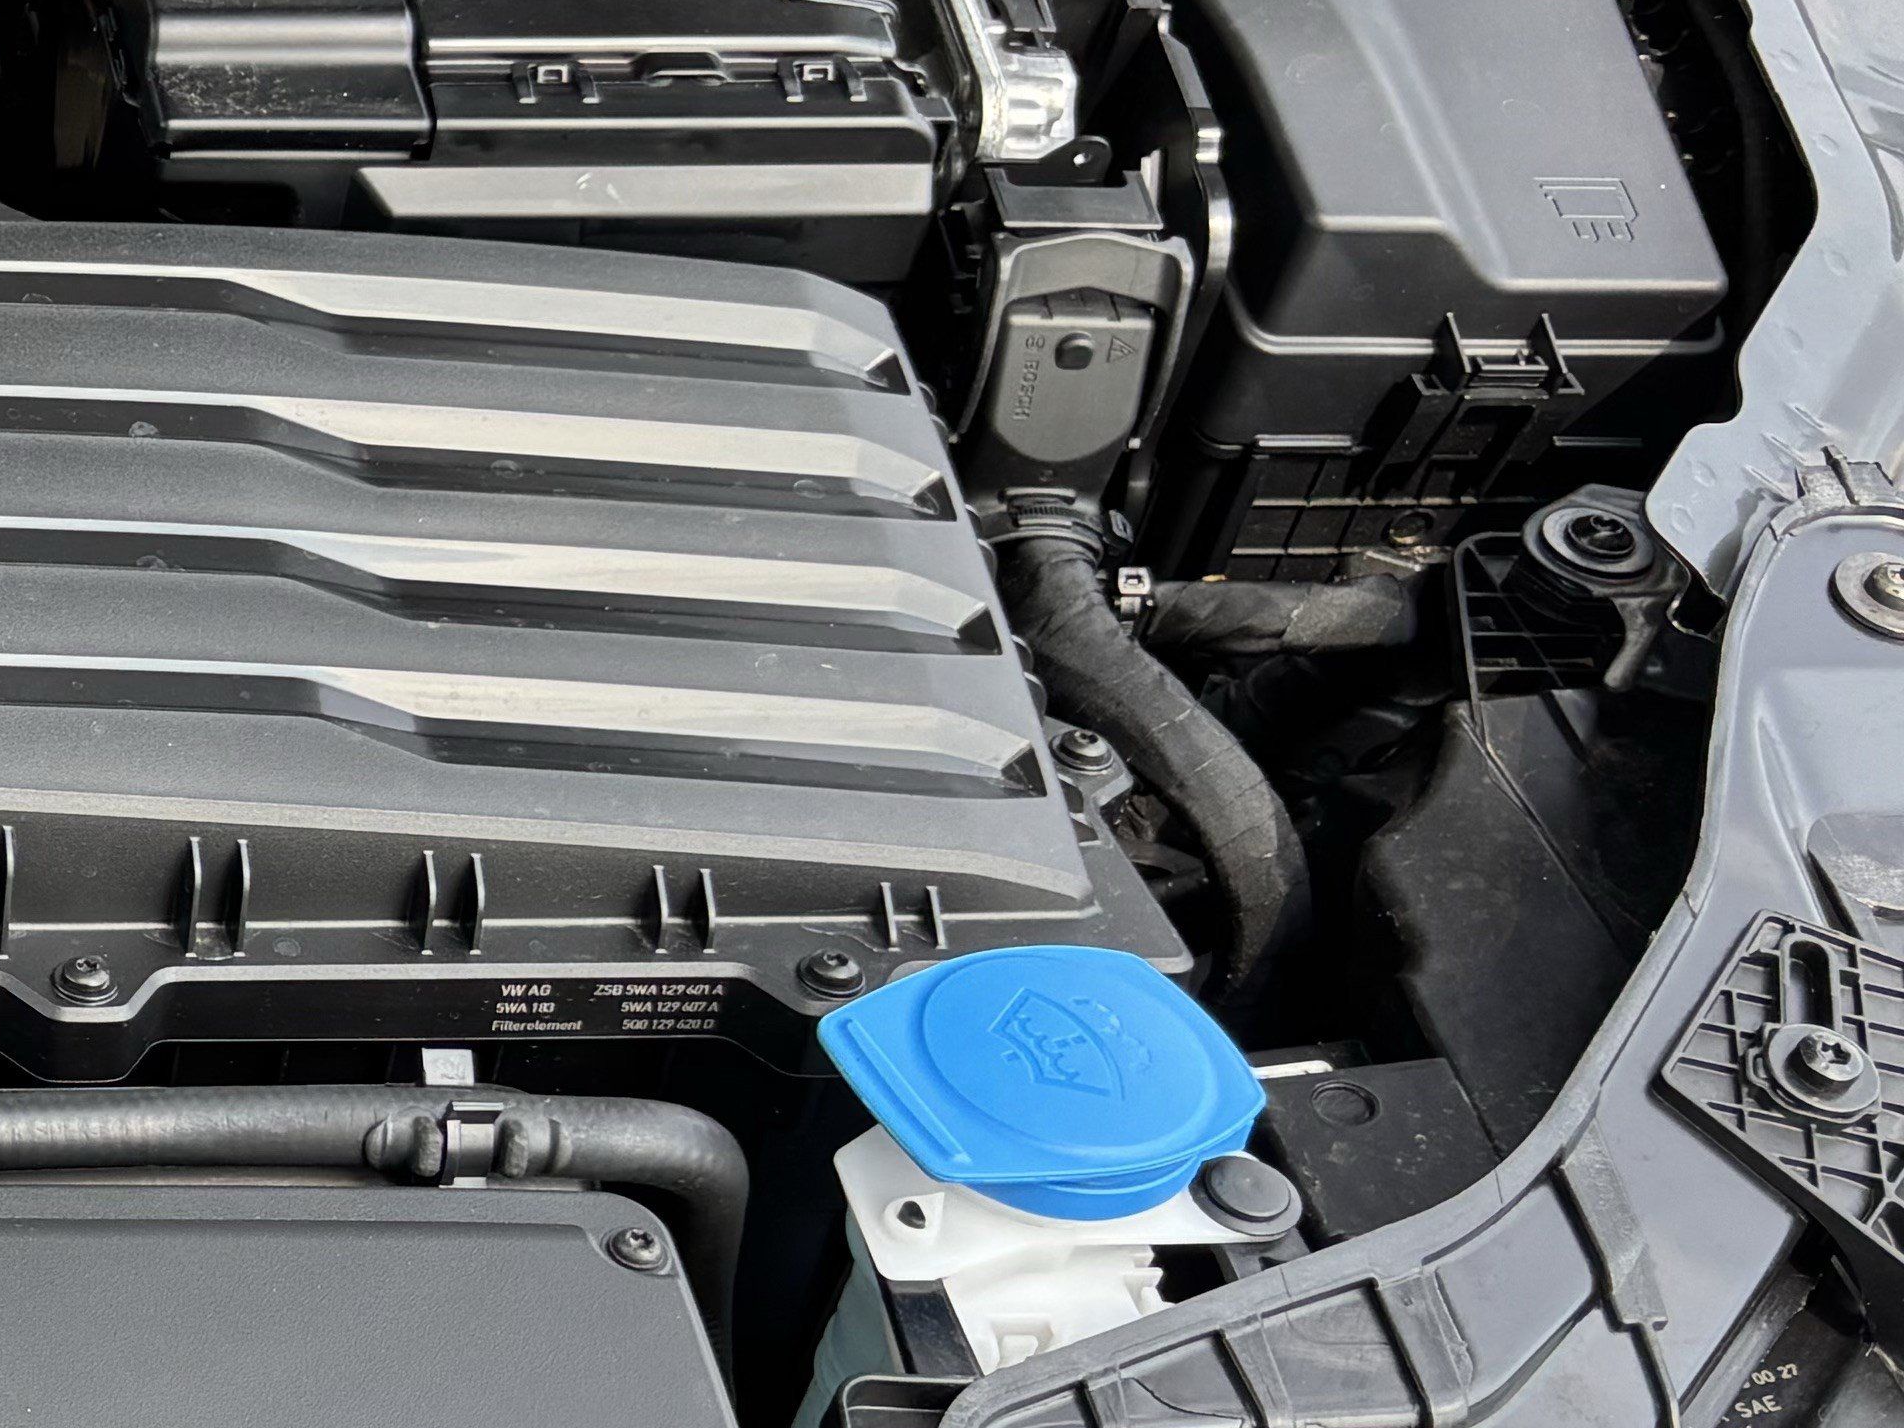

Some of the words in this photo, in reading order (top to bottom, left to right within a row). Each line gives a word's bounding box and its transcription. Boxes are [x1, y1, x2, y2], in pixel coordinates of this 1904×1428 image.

[500, 984, 526, 996] VW
[527, 984, 551, 996] AG
[593, 984, 623, 996] ZSB
[623, 984, 657, 995] 5WA
[661, 984, 685, 995] 129
[711, 984, 723, 995] A
[494, 1002, 527, 1013] 5WA
[619, 1001, 652, 1012] 5WA
[656, 1001, 681, 1012] 129
[706, 1001, 718, 1012] A
[489, 1019, 582, 1031] Filterelement
[651, 1018, 675, 1030] 129
[675, 1018, 701, 1029] 620
[1775, 1361, 1799, 1381] 27
[1733, 1391, 1782, 1422] SAE
